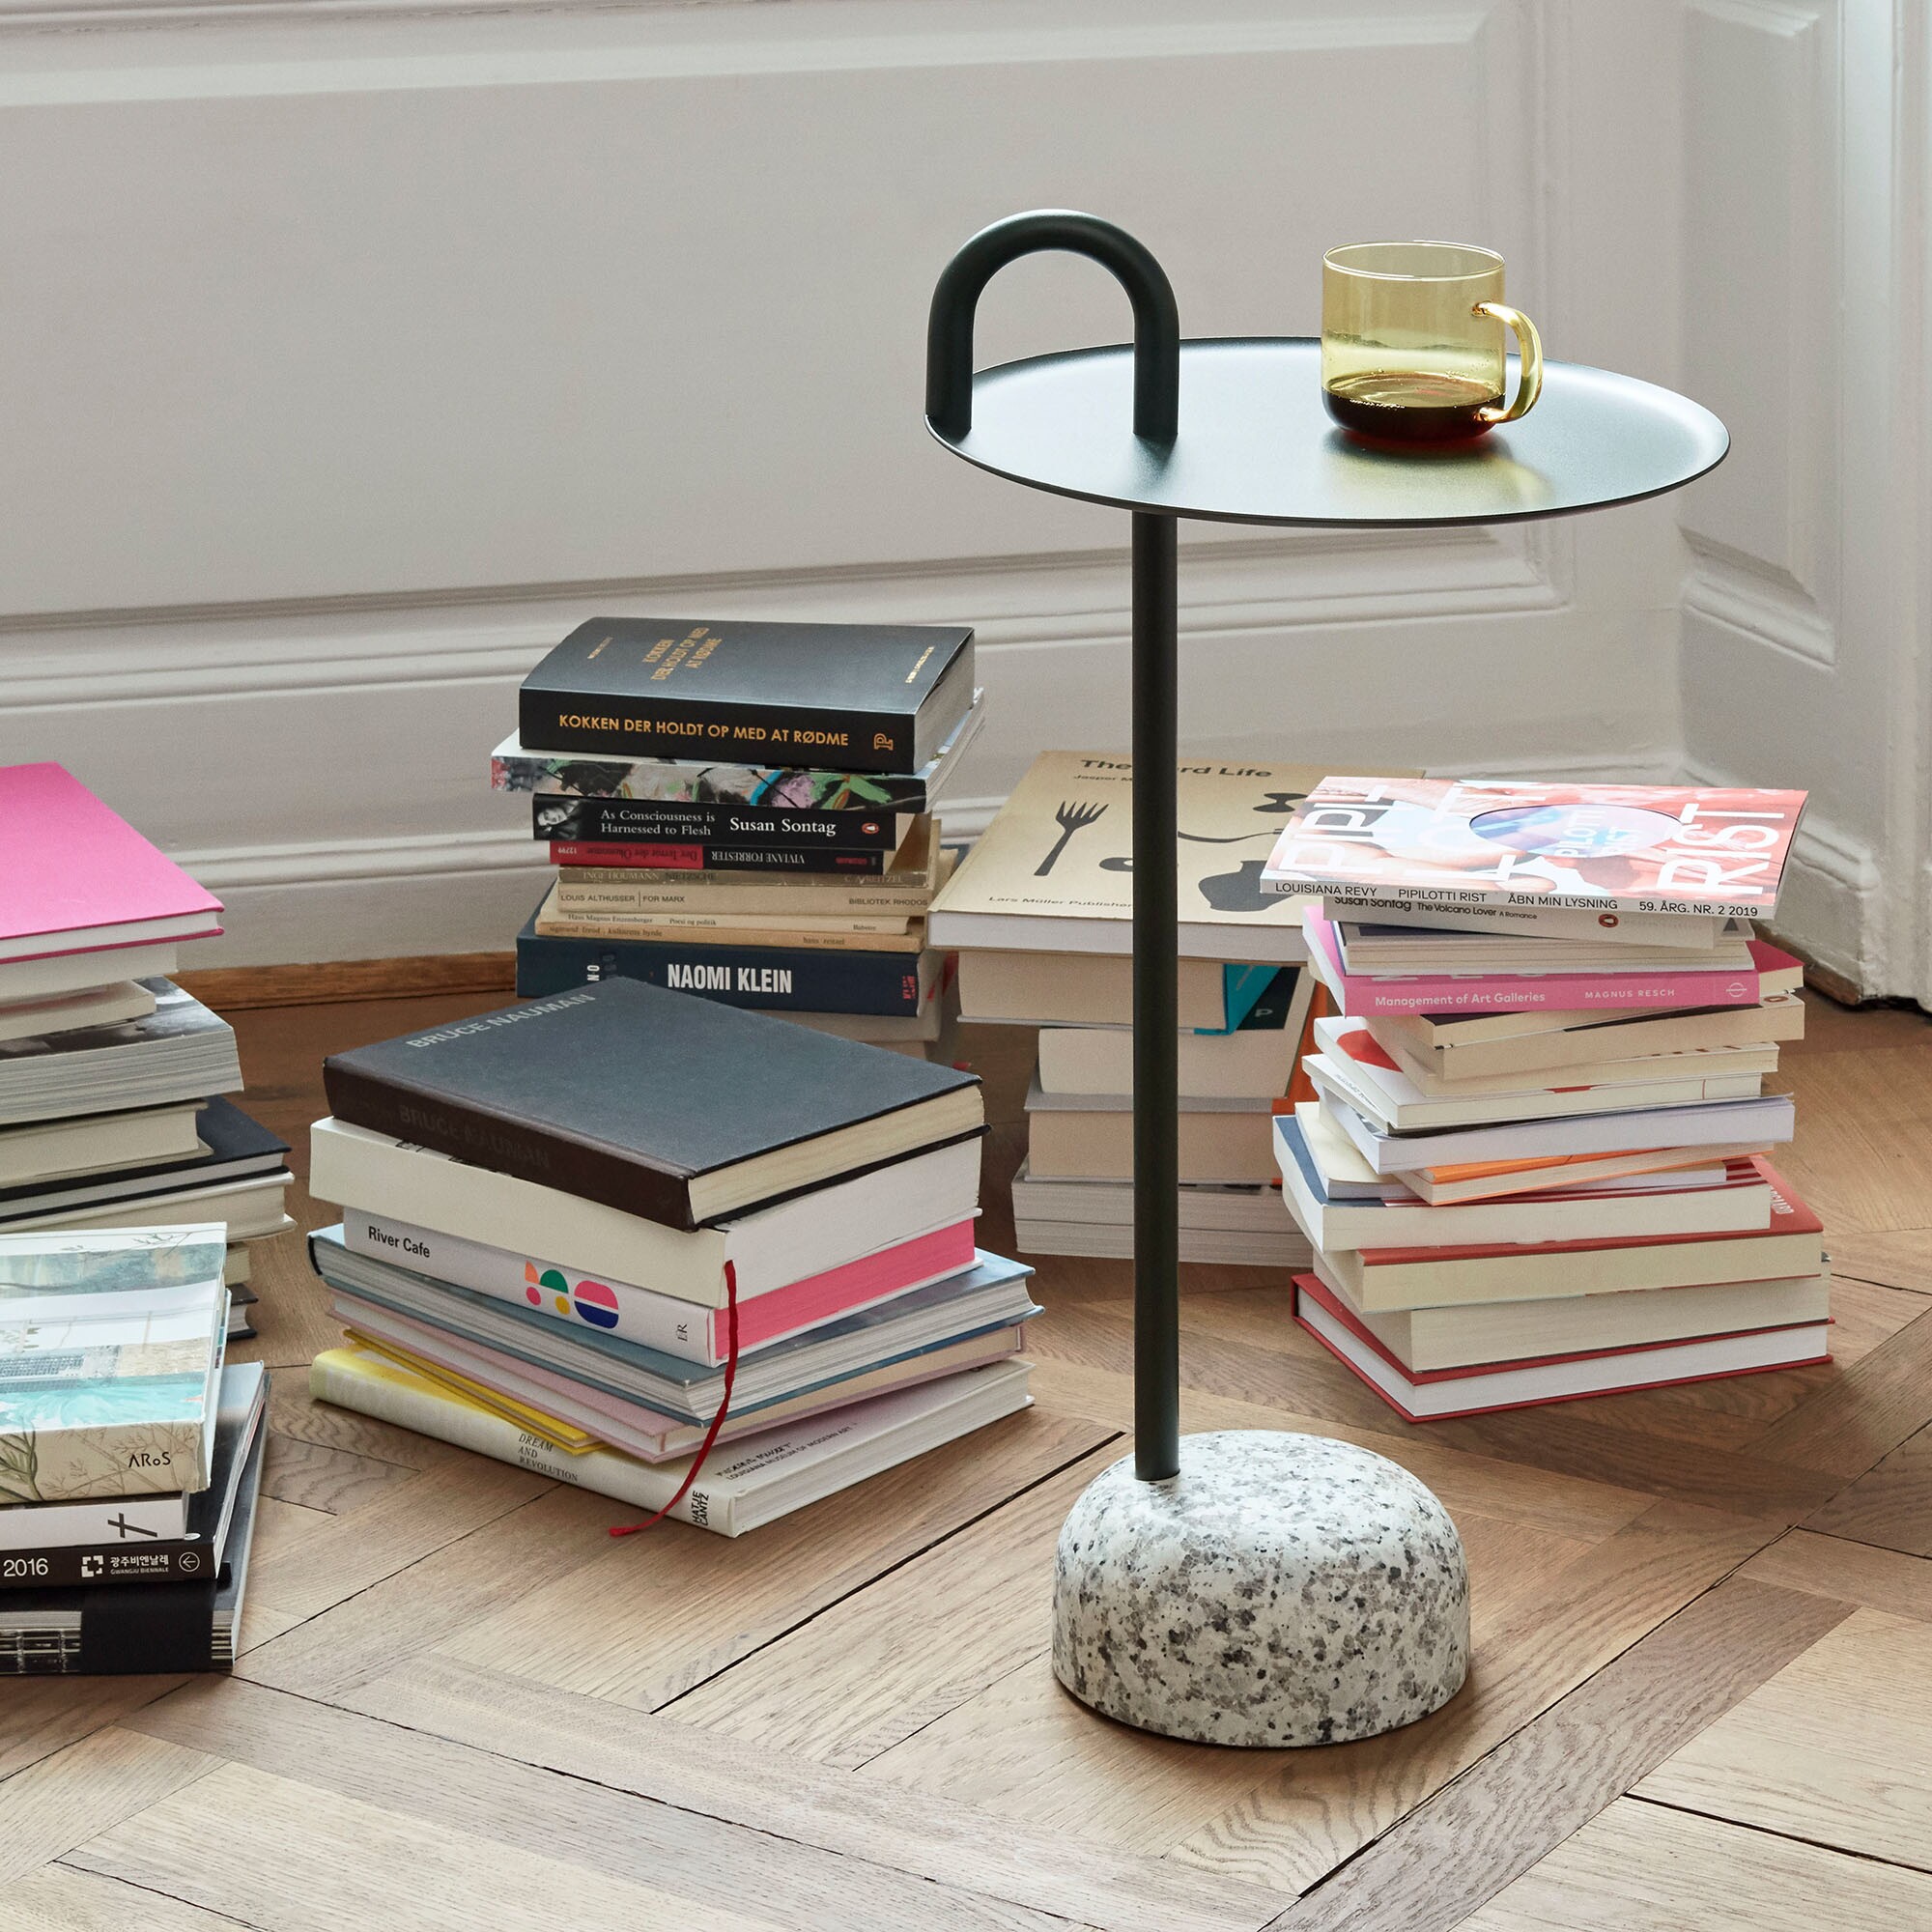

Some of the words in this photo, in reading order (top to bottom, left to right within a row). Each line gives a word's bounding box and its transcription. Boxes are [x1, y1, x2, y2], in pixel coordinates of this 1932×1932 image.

[559, 714, 619, 731] KOKKEN
[624, 719, 651, 733] DER
[656, 721, 704, 737] HOLDT
[707, 724, 729, 738] OP
[733, 726, 766, 741] MED
[771, 728, 790, 742] AT
[793, 729, 849, 746] RØDME
[1081, 759, 1132, 770] The
[1218, 767, 1273, 777] Life
[601, 810, 616, 820] As
[619, 810, 702, 822] Consciousness
[706, 811, 716, 822] is
[601, 822, 661, 835] Harnessed
[665, 826, 677, 835] to
[681, 824, 711, 836] Flesh
[729, 816, 776, 832] Susan
[781, 817, 837, 838] Sontag
[711, 850, 764, 863] FORRESTER
[766, 851, 806, 865] VIVIANE
[1657, 803, 1785, 895] RIST
[662, 895, 685, 903] MARX
[1275, 882, 1342, 895] LOUISIANA
[1345, 886, 1378, 897] REVY
[1398, 889, 1456, 901] PIPILOTTI
[1460, 892, 1487, 902] RIST
[1508, 893, 1535, 906] ÅBN
[1538, 896, 1562, 907] MIN
[1565, 897, 1618, 910] LYSNING
[1639, 901, 1657, 912] 59.
[1660, 901, 1690, 914] ÅRG.
[1693, 904, 1715, 915] NR.
[1718, 906, 1725, 915] 2
[1729, 906, 1758, 917] 2019
[1334, 896, 1368, 907] Susan
[1417, 901, 1435, 912] The
[1435, 903, 1470, 915] Volcano
[1472, 906, 1497, 917] Lover
[1505, 911, 1538, 920] Romance
[668, 963, 731, 991] NAOMI
[737, 967, 792, 994] KLEIN
[1375, 995, 1453, 1008] Management
[1456, 994, 1468, 1005] of
[1470, 993, 1491, 1004] Art
[1494, 991, 1546, 1004] Galleries
[1584, 989, 1634, 999] MAGNUS
[1637, 988, 1675, 998] RESCH
[406, 1022, 492, 1048] BRUCE
[487, 994, 596, 1027] NAUMAN
[368, 1225, 400, 1248] River
[403, 1236, 431, 1258] Cafe
[518, 1446, 538, 1459] AND
[519, 1433, 554, 1452] DREAM
[519, 1456, 579, 1482] REVOLUTION
[691, 1491, 701, 1523] HATJE
[698, 1492, 710, 1526] CANTZ
[3, 1557, 49, 1577] 2016
[110, 1554, 169, 1568] 광주비엔날레
